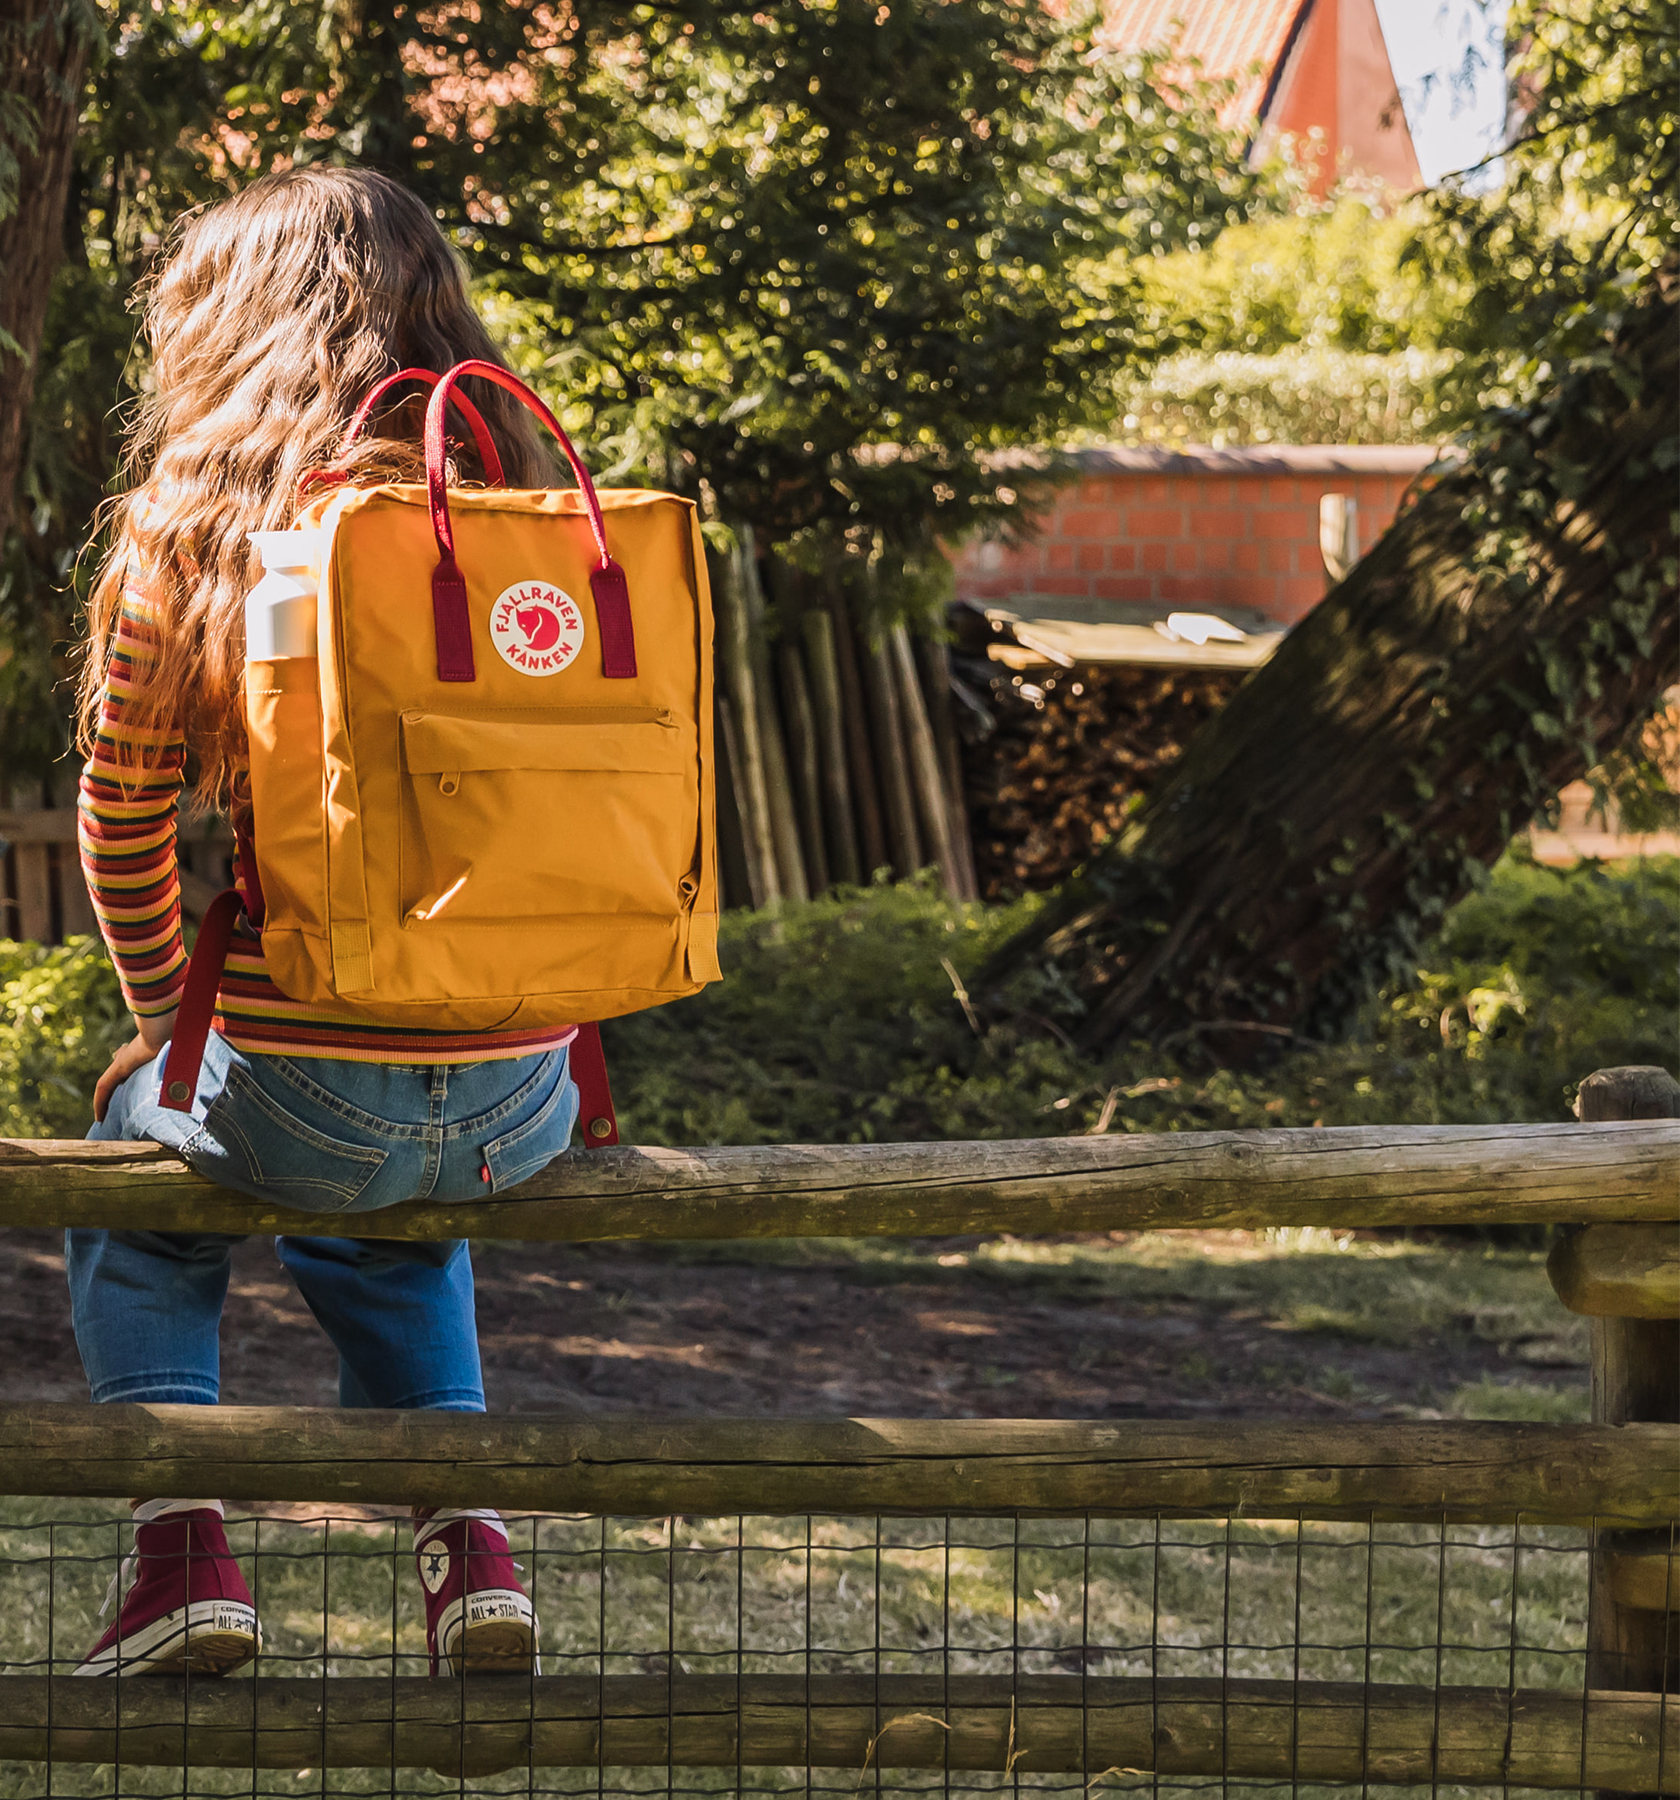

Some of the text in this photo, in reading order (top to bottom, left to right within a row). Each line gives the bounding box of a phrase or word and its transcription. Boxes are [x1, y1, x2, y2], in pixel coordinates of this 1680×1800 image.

[496, 586, 578, 633] FJÄLLRÄVEN
[471, 1604, 518, 1621] ALL STAR
[218, 1615, 232, 1630] ALL
